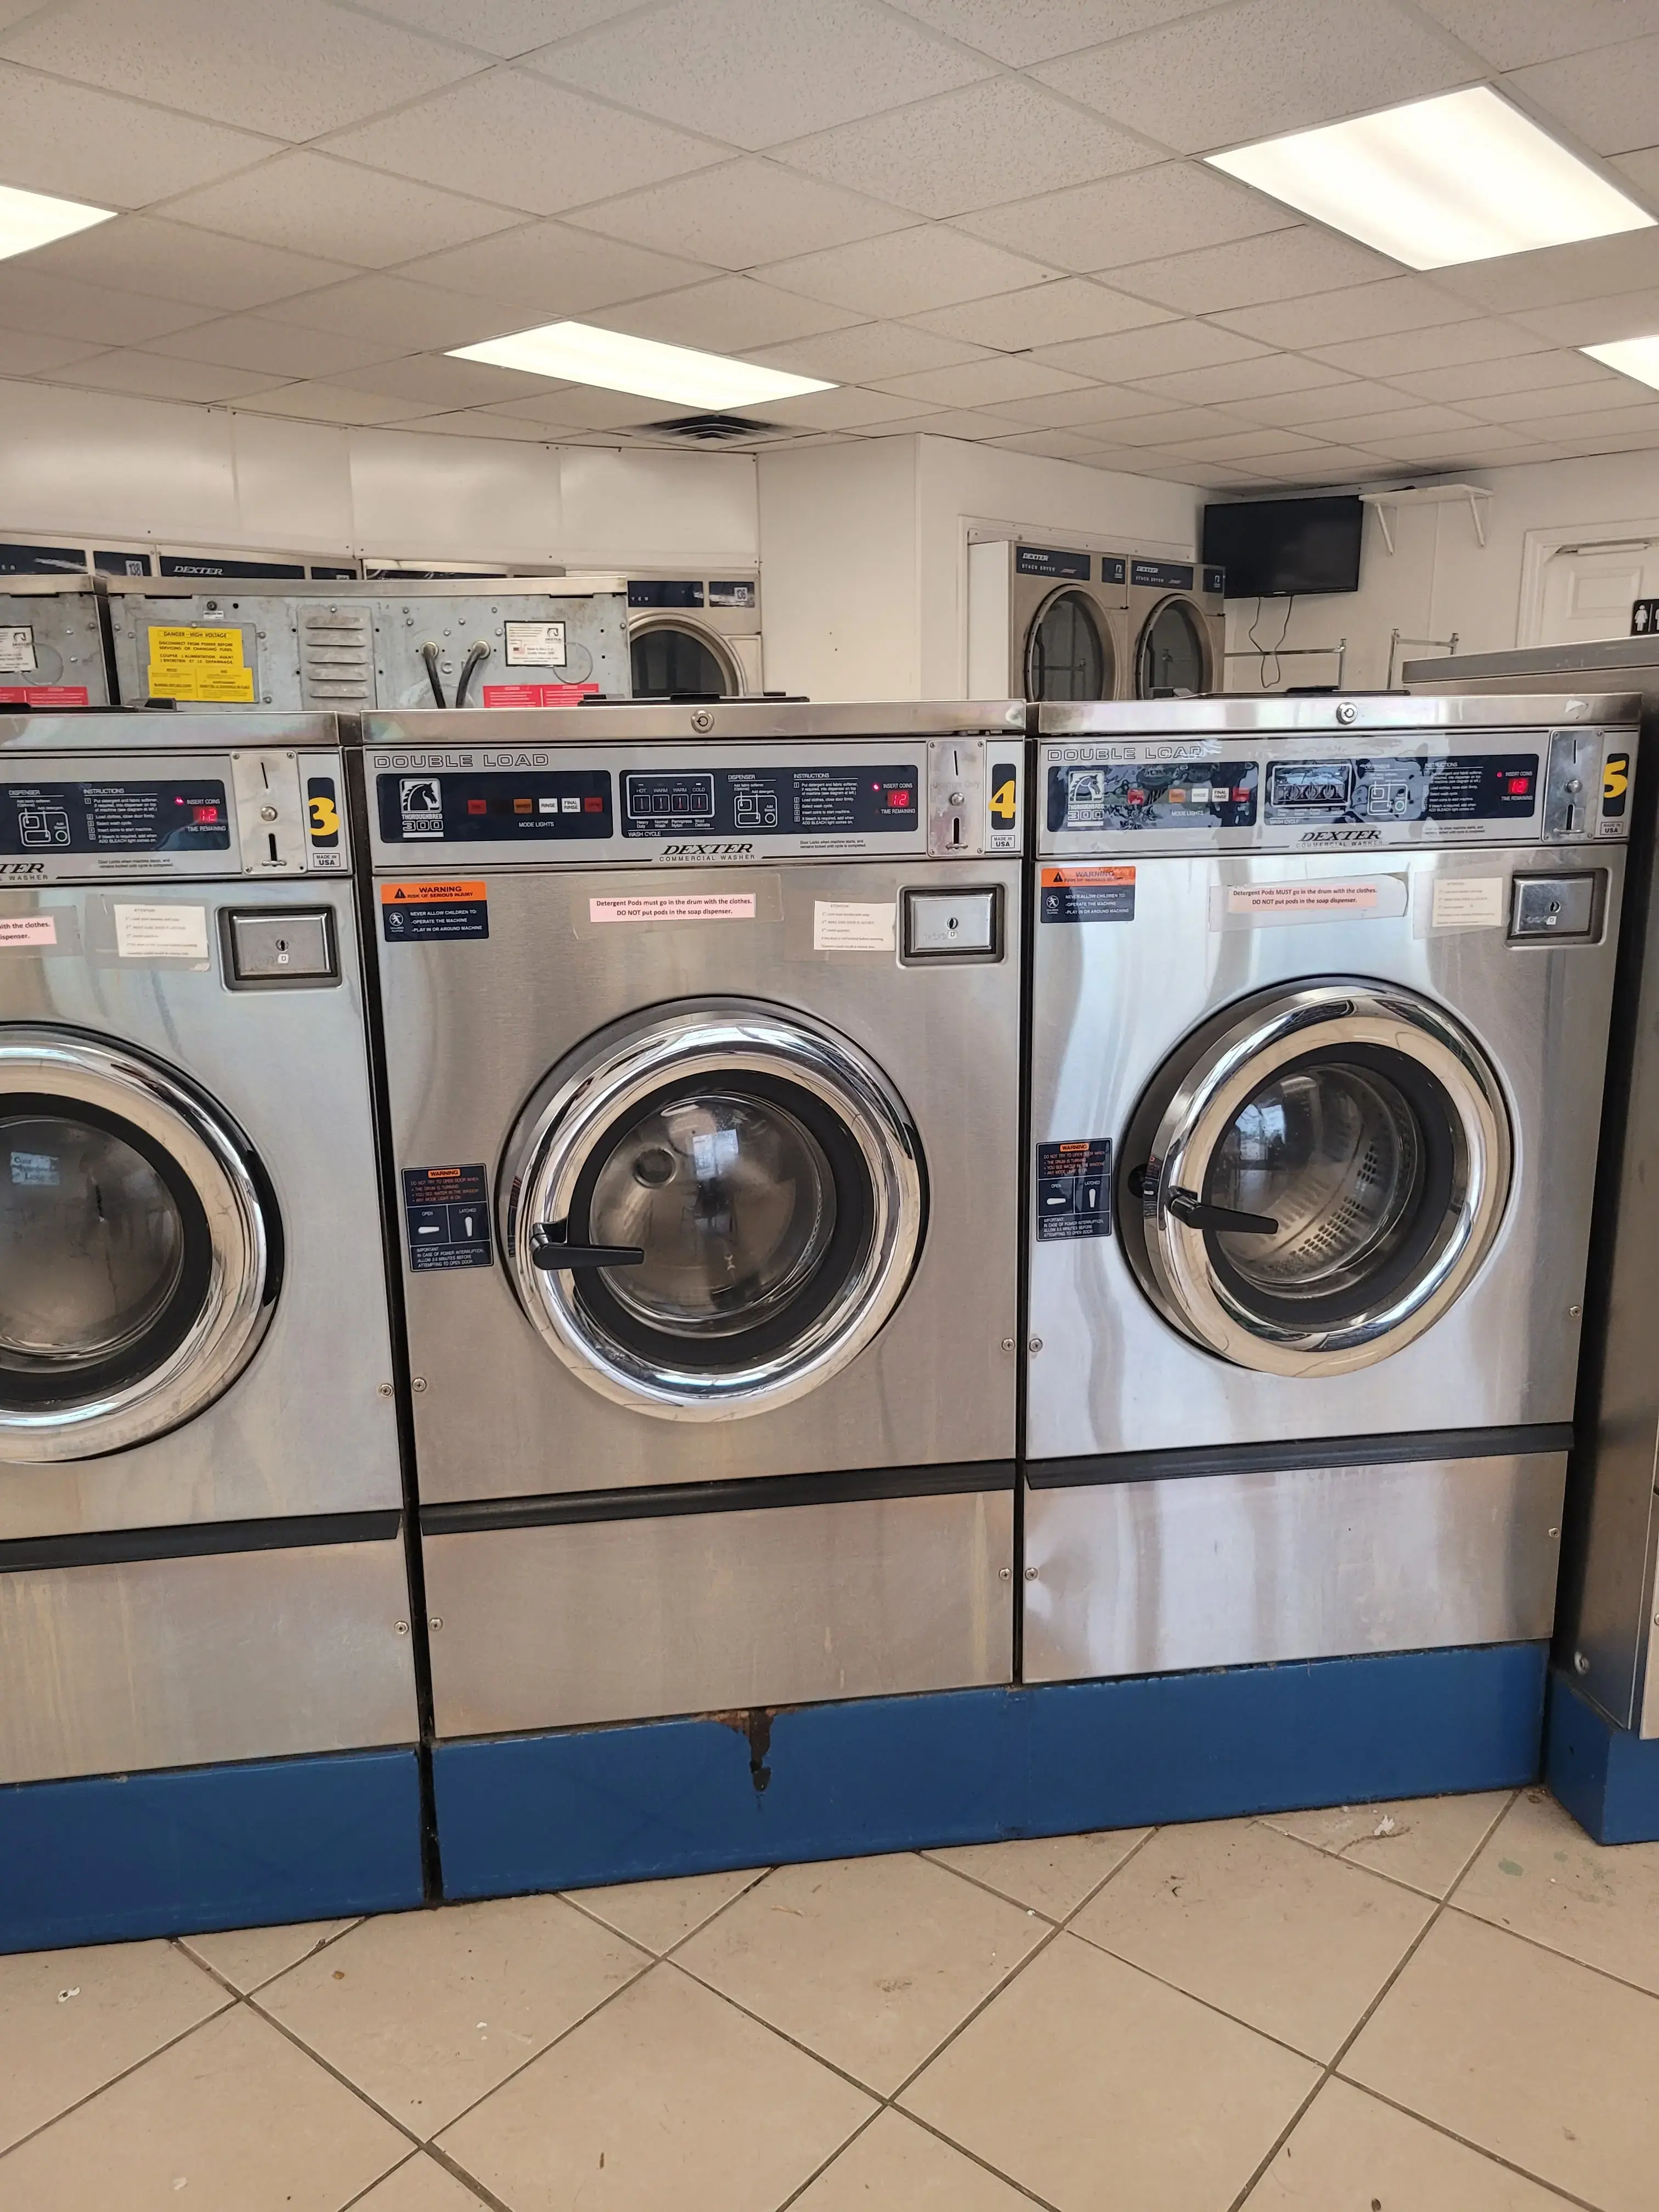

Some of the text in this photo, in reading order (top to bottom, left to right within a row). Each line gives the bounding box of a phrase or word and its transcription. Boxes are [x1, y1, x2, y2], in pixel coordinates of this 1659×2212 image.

[1023, 553, 1048, 561] DEXTER
[173, 566, 223, 575] DEXTER
[1047, 747, 1201, 761] DOUBLE LOAD
[374, 754, 549, 768] DOUBLE LOAD
[1603, 760, 1628, 798] 5
[894, 794, 906, 805] 12
[988, 780, 1016, 819] 4
[202, 808, 217, 821] 12
[308, 797, 340, 836] 3
[1068, 810, 1104, 820] 300
[403, 820, 443, 831] 300
[1298, 831, 1381, 841] DEXTER
[661, 844, 753, 855] DEXTER
